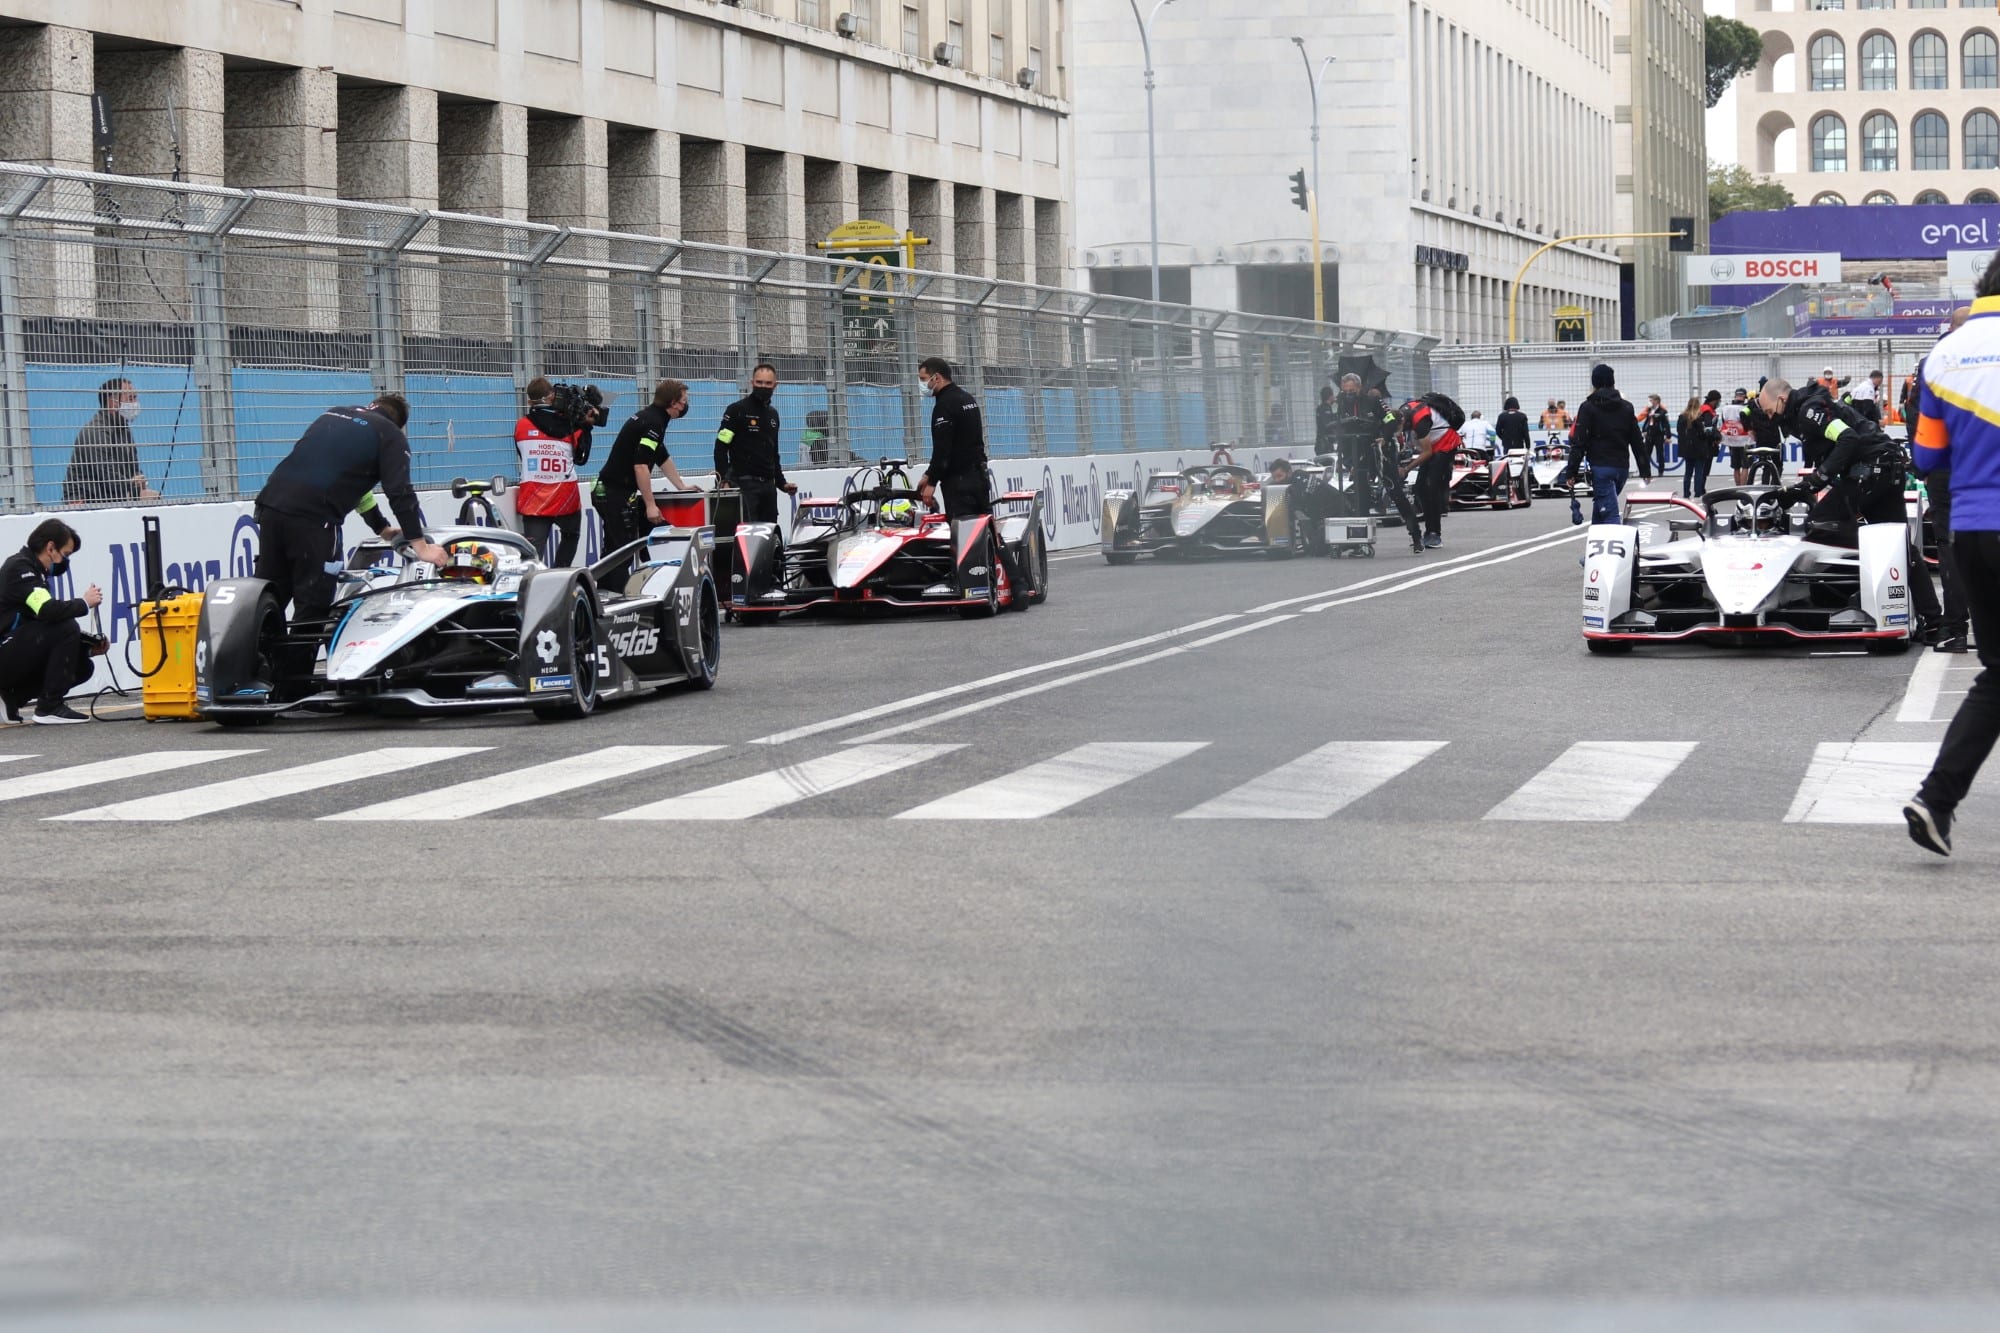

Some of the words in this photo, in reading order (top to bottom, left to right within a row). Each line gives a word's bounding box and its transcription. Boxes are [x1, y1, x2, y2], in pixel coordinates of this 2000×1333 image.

[1921, 218, 1988, 244] enel
[1083, 248, 1148, 268] DEL
[1190, 246, 1341, 266] LAVORO
[1745, 260, 1818, 278] BOSCH
[541, 458, 567, 473] 061
[1061, 474, 1090, 525] Allianz
[735, 525, 772, 540] 22
[1589, 539, 1626, 559] 36
[109, 542, 221, 644] Alanz
[210, 586, 237, 605] 5
[613, 613, 632, 625] Powered
[632, 611, 641, 623] by
[608, 625, 661, 658] stas
[597, 645, 610, 677] 5
[542, 679, 571, 689] MICHELIN
